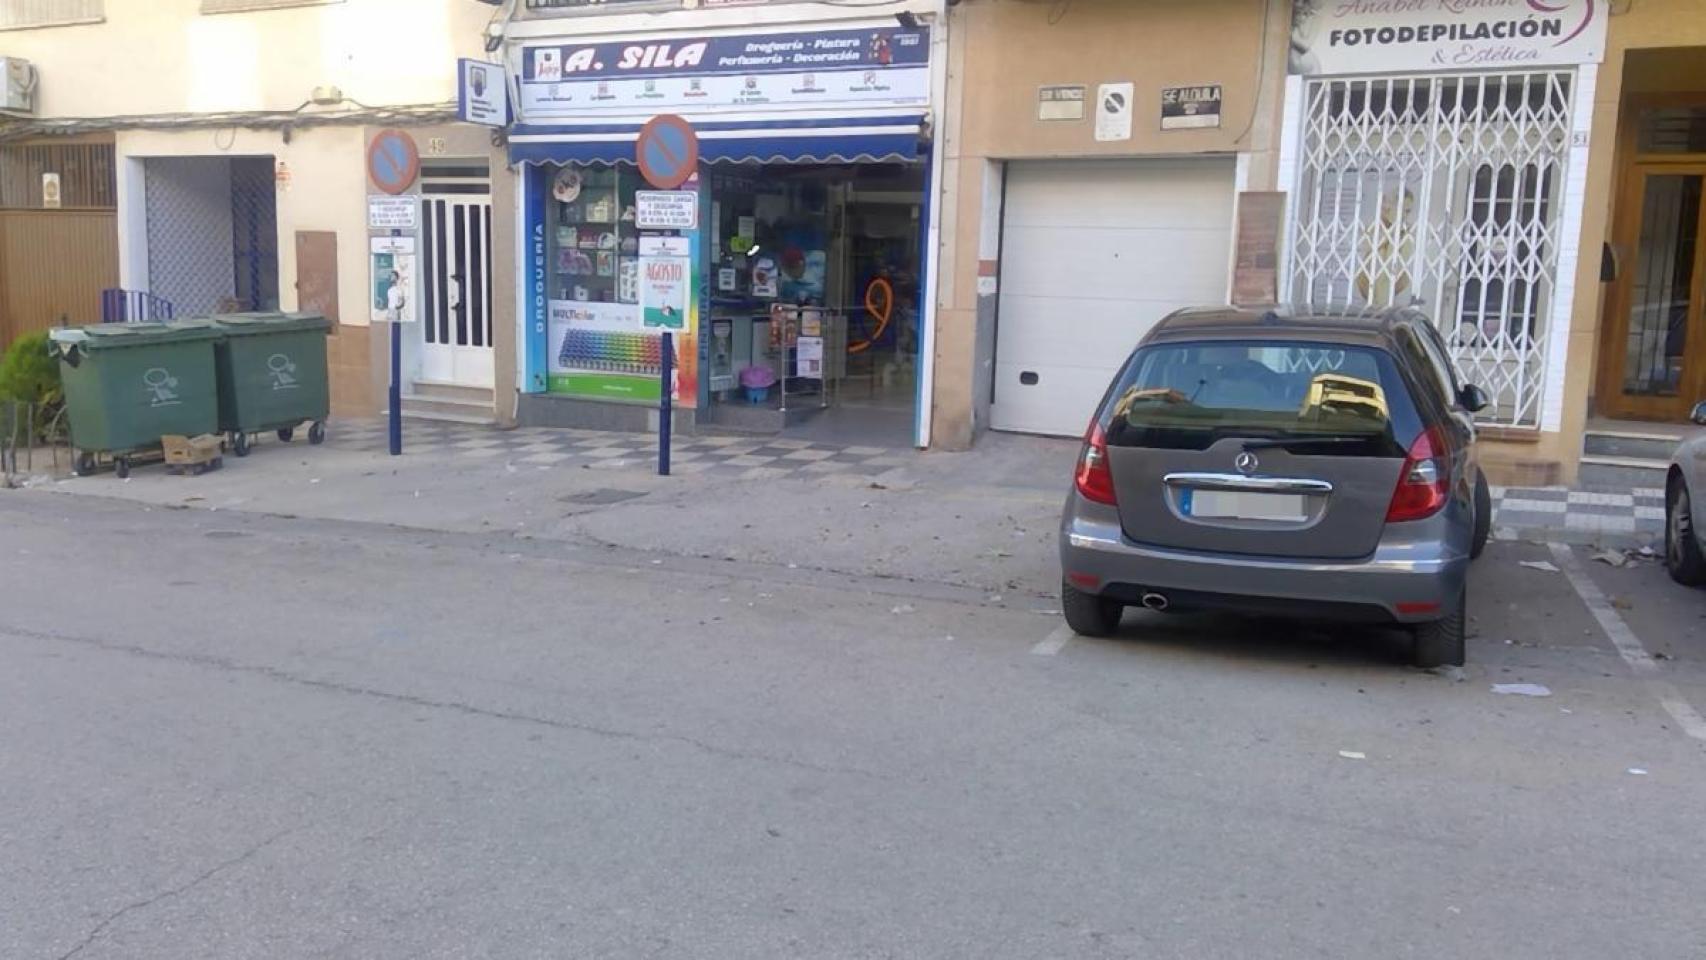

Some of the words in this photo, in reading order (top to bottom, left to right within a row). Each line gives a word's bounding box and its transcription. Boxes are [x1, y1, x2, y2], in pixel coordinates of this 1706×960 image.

[1329, 14, 1562, 47] FOTODEPILACIÓN
[745, 40, 804, 52] Droguería
[813, 38, 861, 49] Pintura
[1453, 44, 1540, 64] Estética
[565, 48, 604, 72] A.
[617, 43, 707, 69] SILA
[718, 54, 783, 66] Perfumería
[793, 50, 861, 63] Decoración
[1163, 90, 1177, 103] SE
[1178, 87, 1220, 102] ALQUILA
[535, 224, 544, 332] DROGUERÍA
